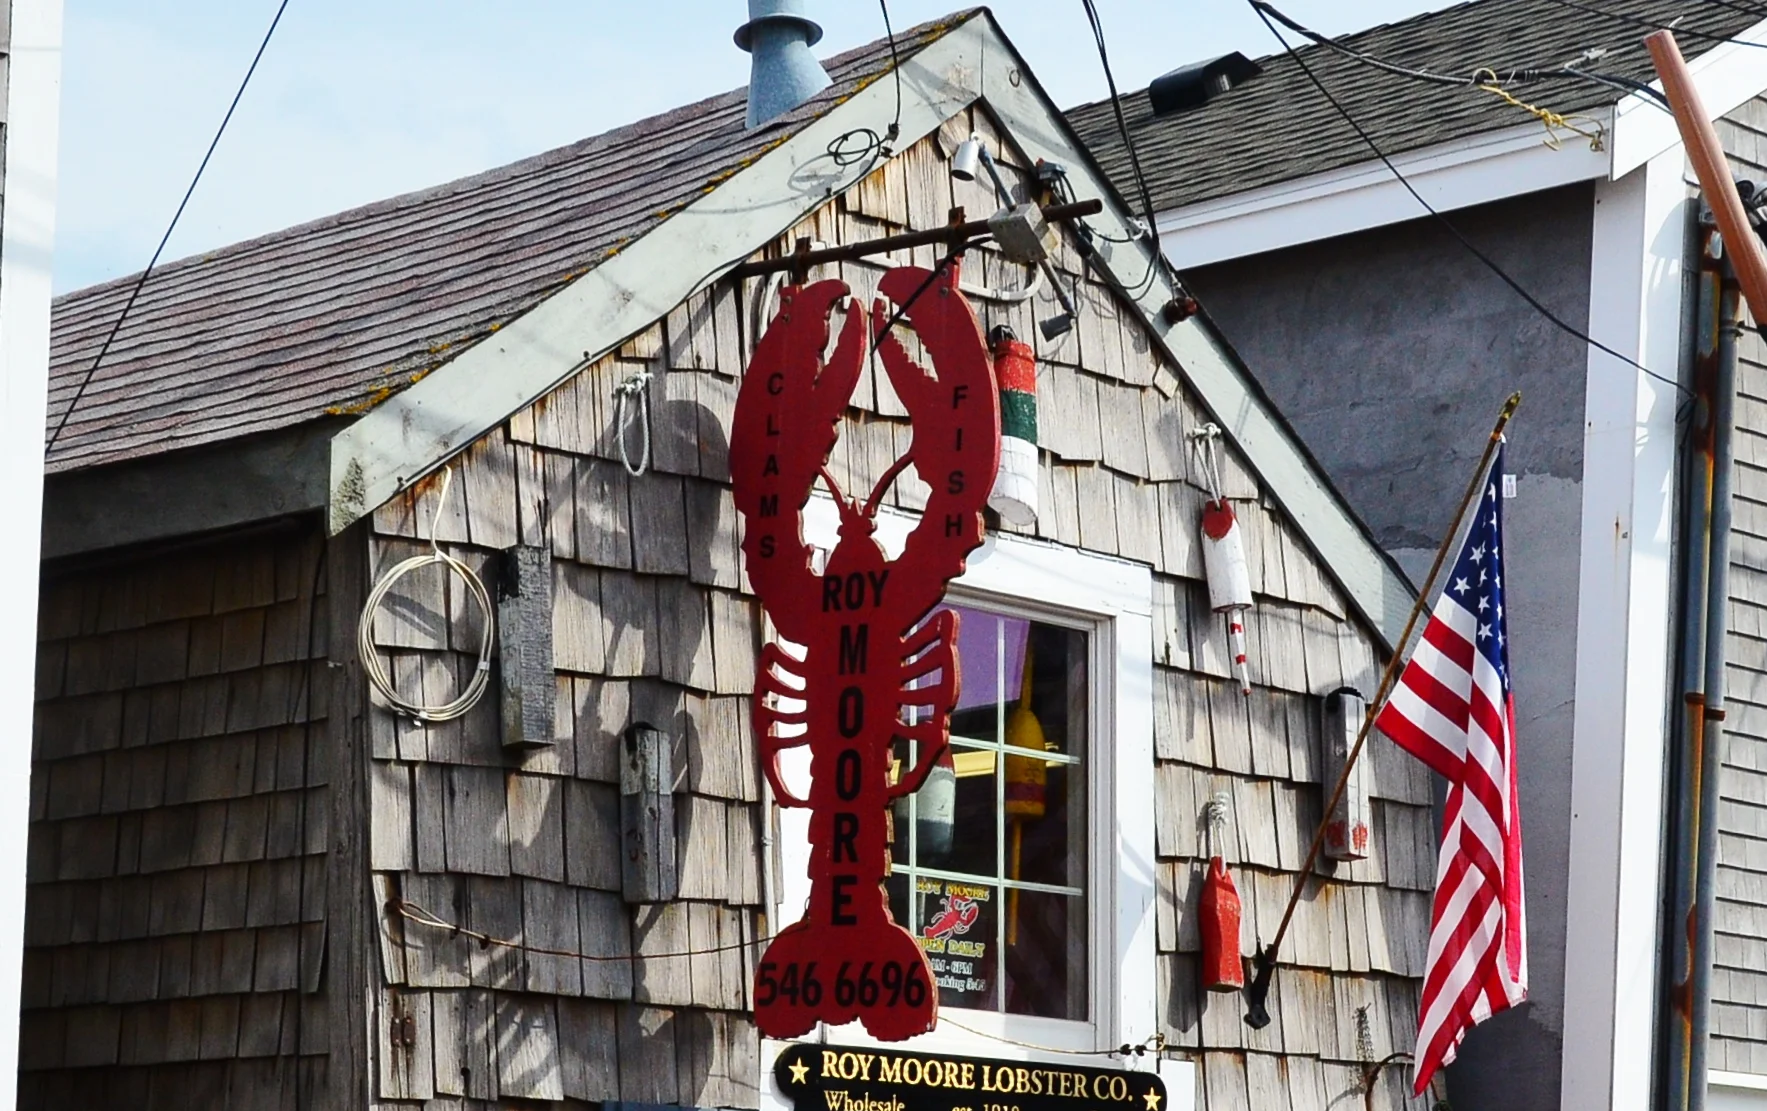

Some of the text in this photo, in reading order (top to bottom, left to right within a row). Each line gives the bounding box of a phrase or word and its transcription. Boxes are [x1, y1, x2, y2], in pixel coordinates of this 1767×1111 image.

[759, 372, 784, 558] CLAMS
[945, 384, 969, 537] FISH
[822, 570, 890, 613] ROY
[831, 623, 868, 926] MOORE
[948, 939, 985, 958] DAILY
[758, 960, 926, 1009] 546 6696
[821, 1050, 1133, 1102] ROY MOORE LOBSTER CO.
